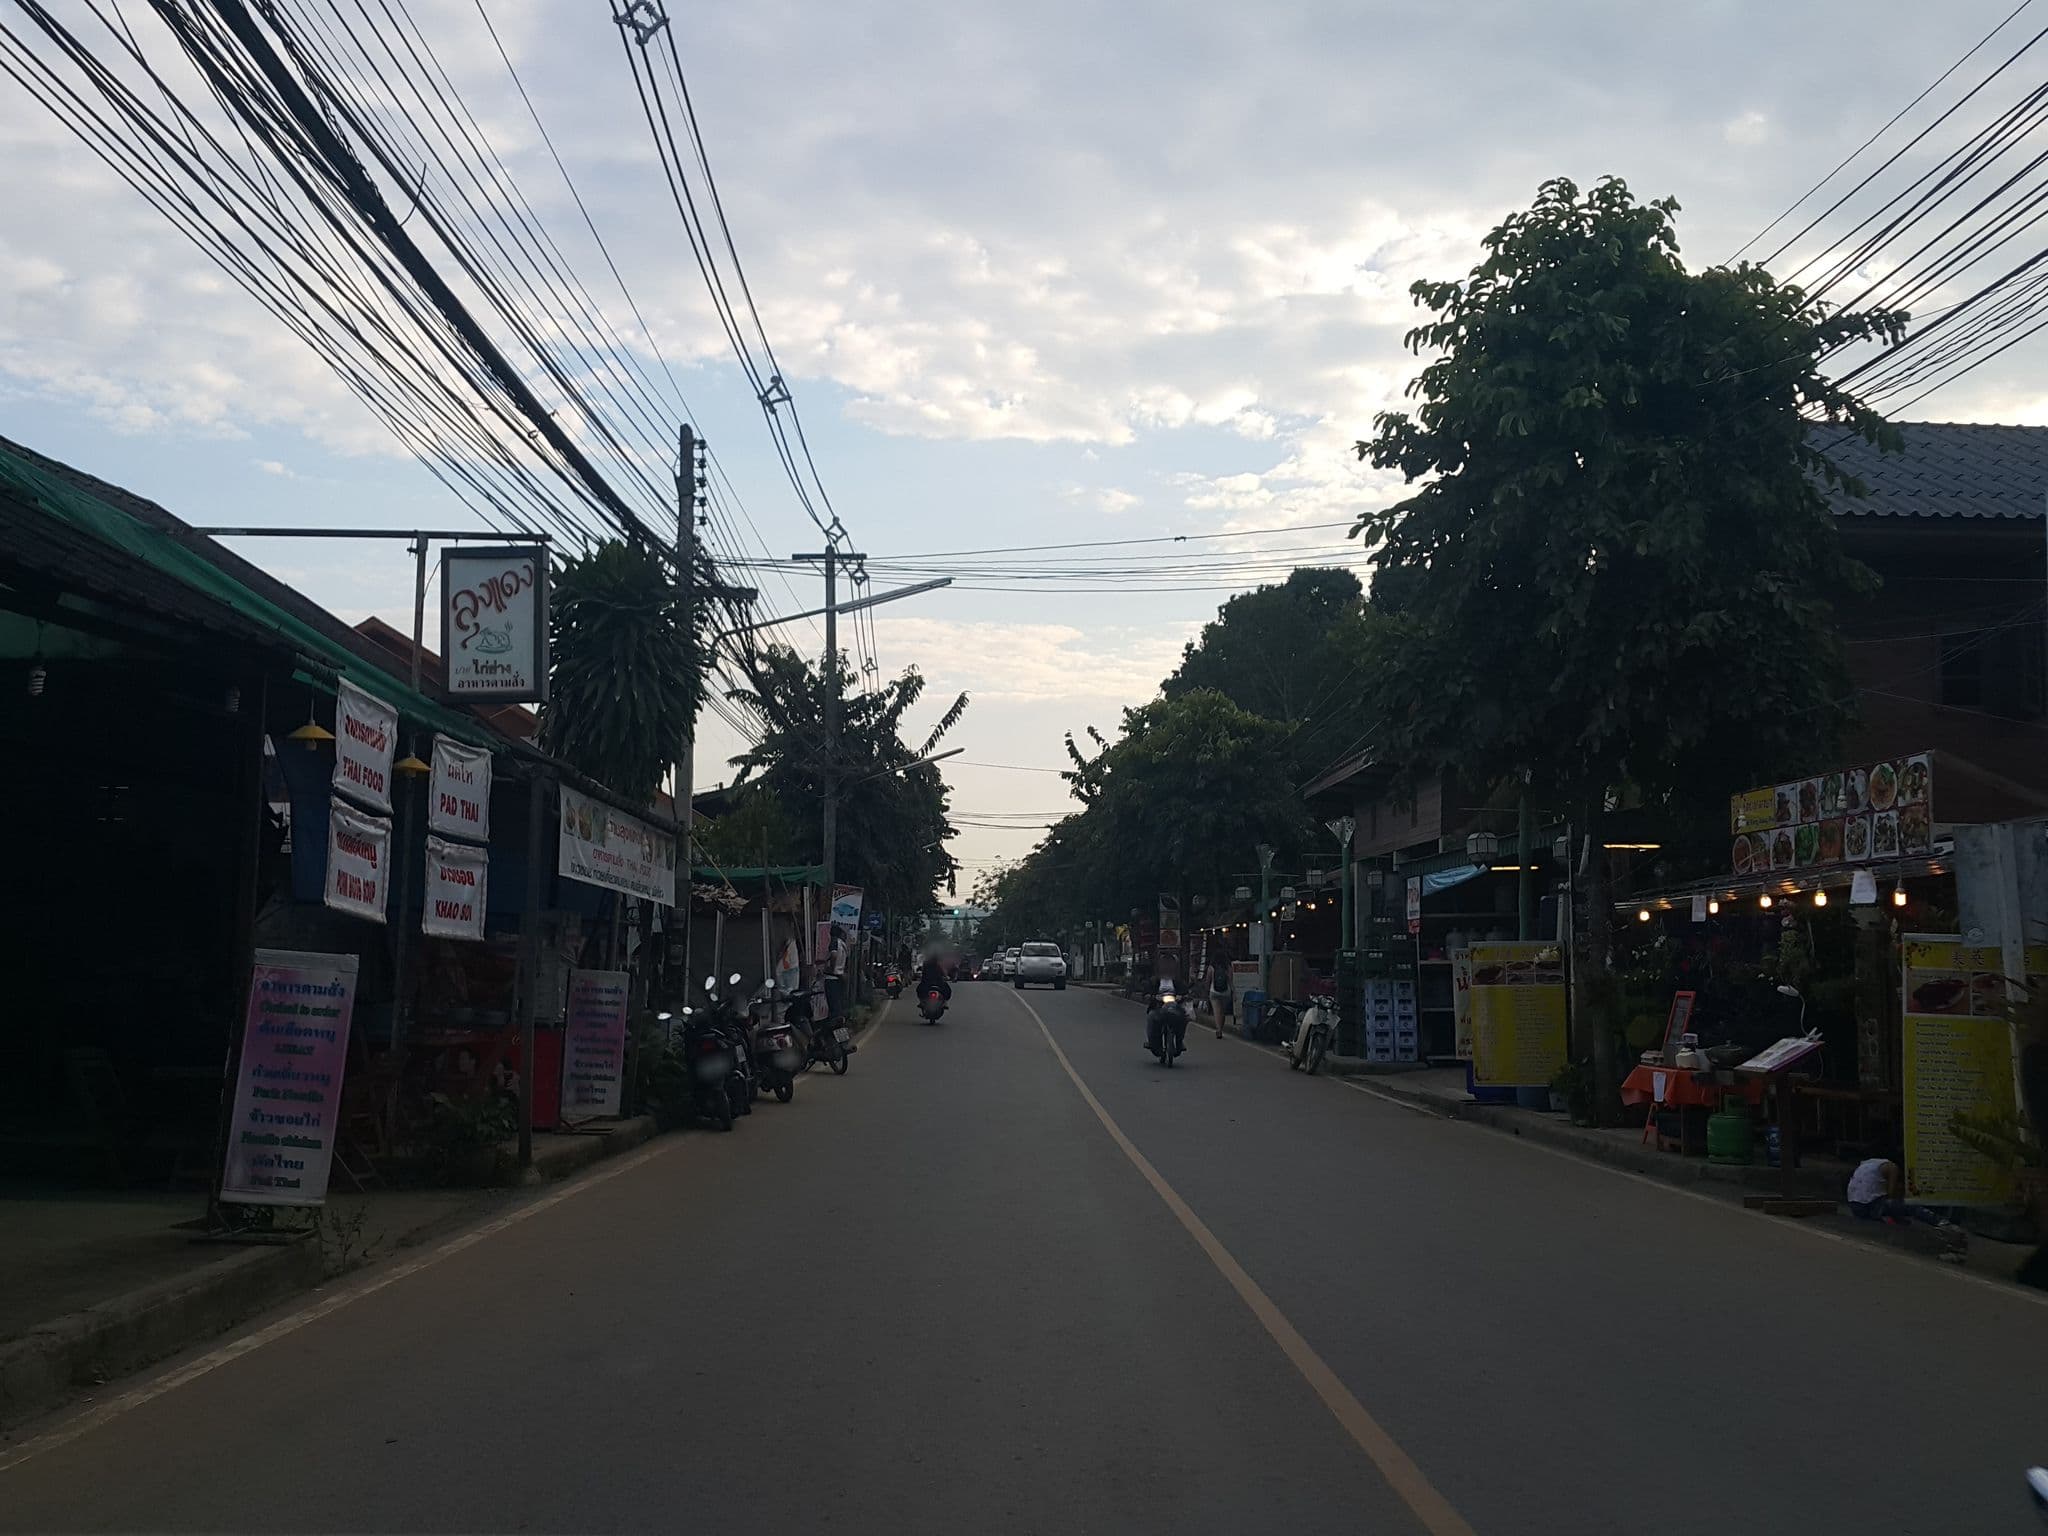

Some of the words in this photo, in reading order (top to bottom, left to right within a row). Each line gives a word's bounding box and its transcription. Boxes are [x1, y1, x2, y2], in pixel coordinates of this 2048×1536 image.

[452, 564, 533, 649] ลุงแดง
[472, 659, 512, 675] ไก่ย่าง
[457, 671, 525, 688] อาหารตามสั่ง
[343, 756, 361, 784] THAI
[362, 766, 384, 792] FOOD
[440, 793, 458, 816] PAD
[460, 799, 479, 822] THAI
[435, 899, 460, 919] KHAO
[460, 904, 472, 921] SOI
[261, 976, 345, 998] อาหารตามสั่ง
[248, 1107, 321, 1127] ข้าวซอยไก่
